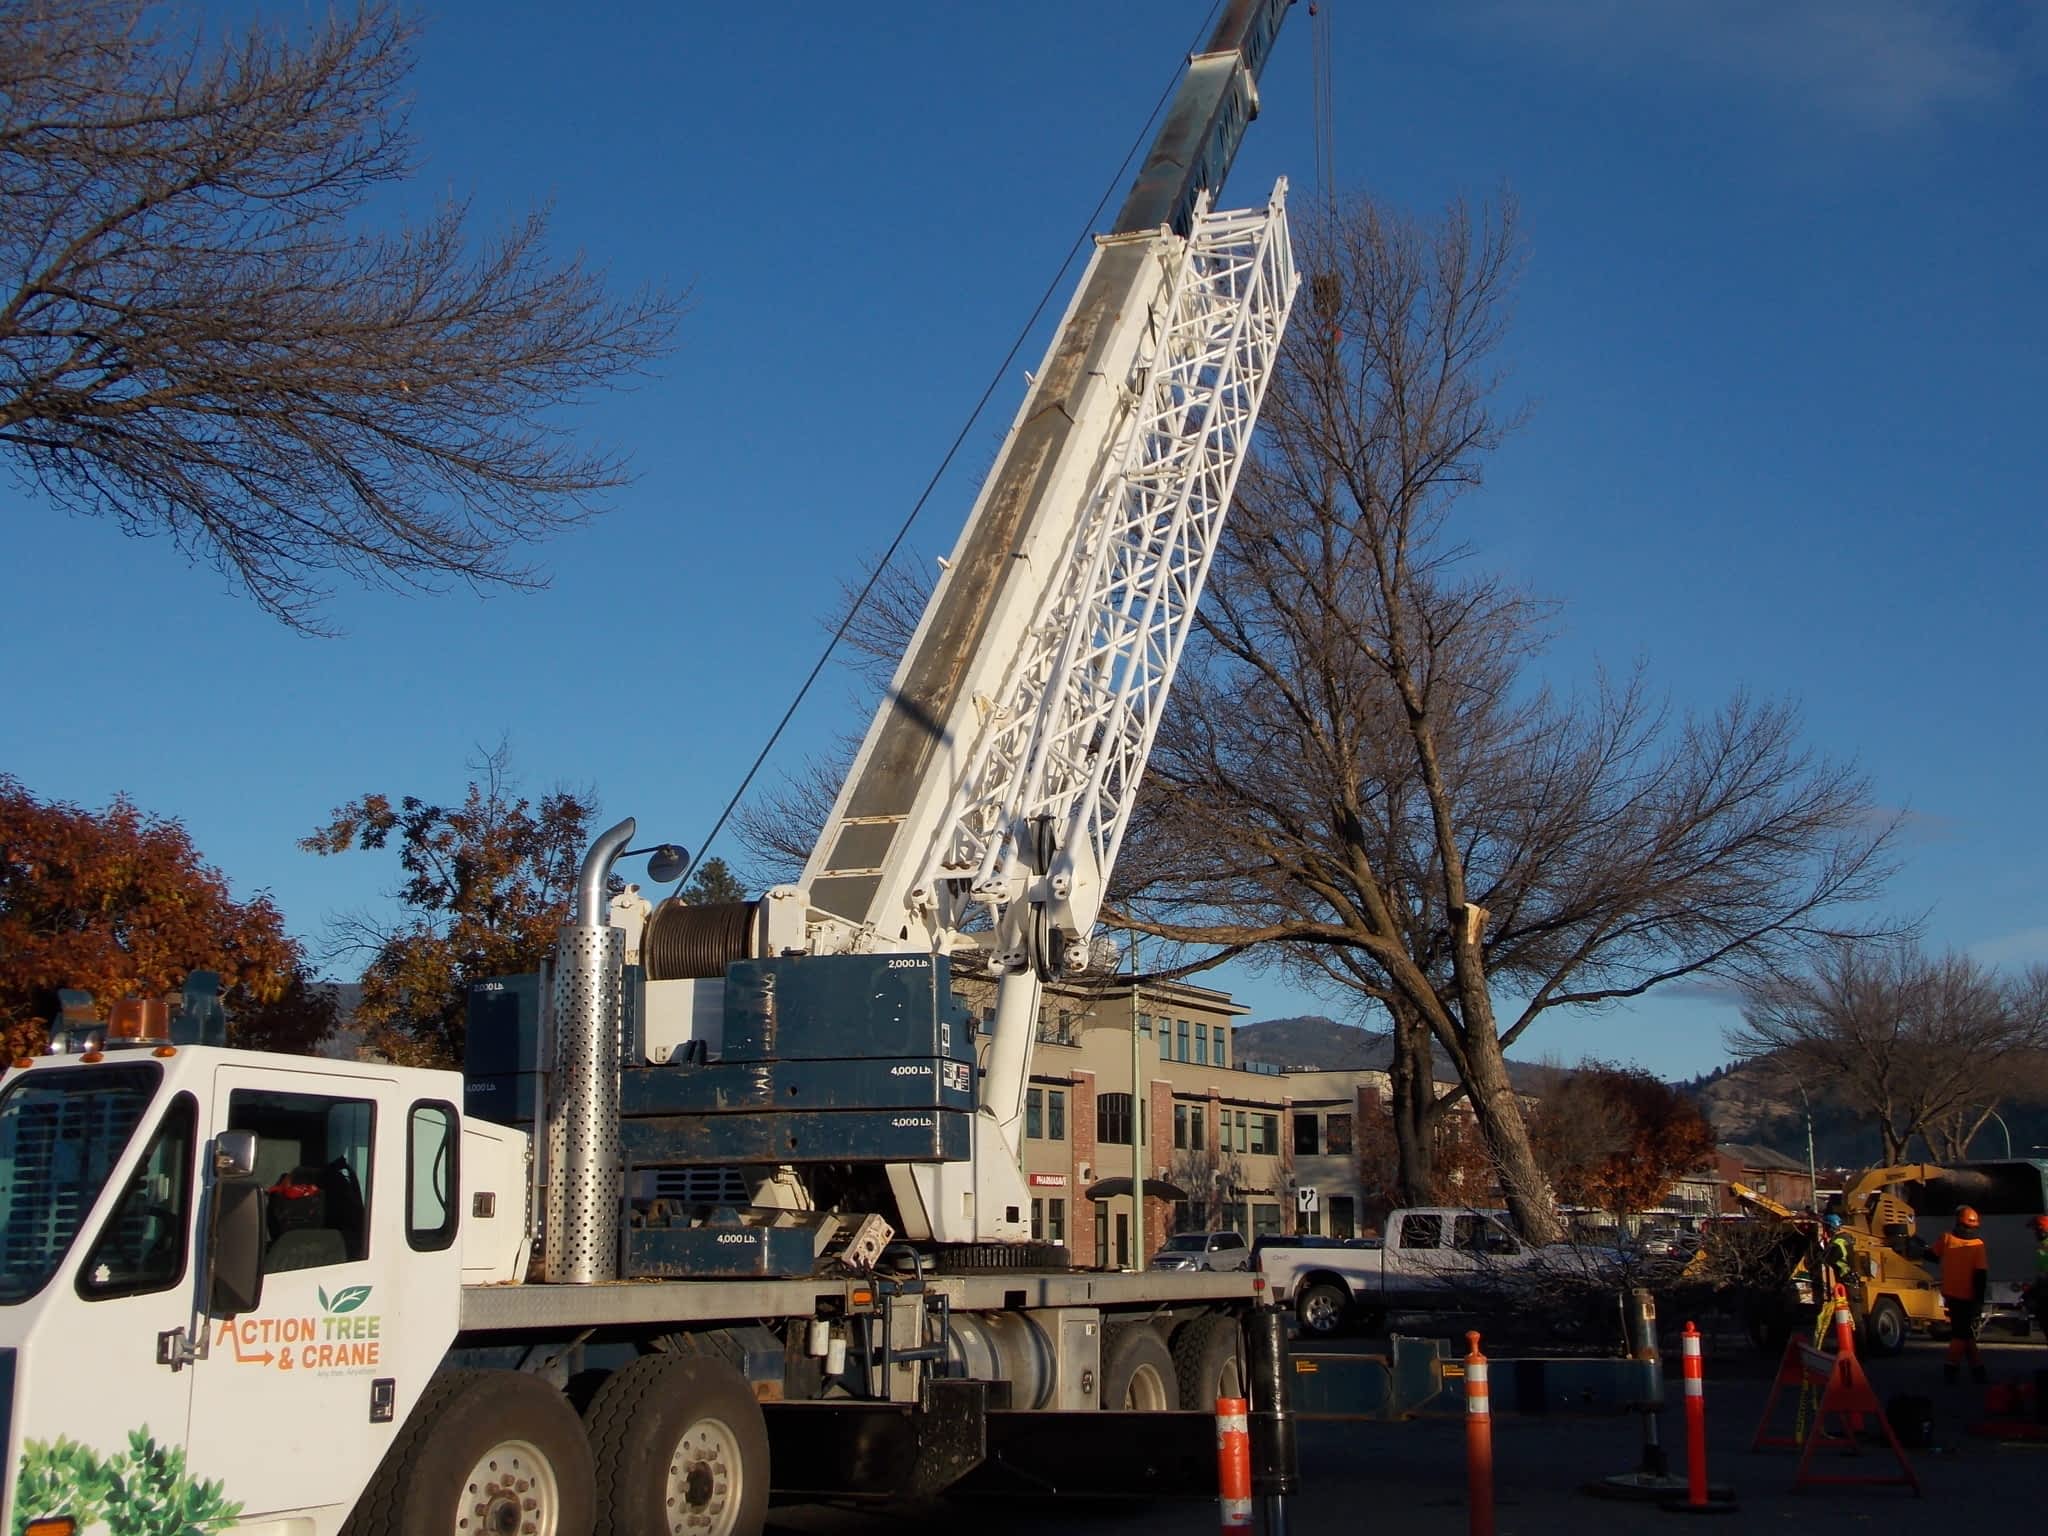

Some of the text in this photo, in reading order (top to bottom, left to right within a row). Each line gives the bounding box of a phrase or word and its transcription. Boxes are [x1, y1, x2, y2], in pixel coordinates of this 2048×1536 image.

[888, 959, 930, 969] 2,000 Lb.
[890, 1066, 933, 1076] 4,000 Lb.
[891, 1117, 919, 1128] 4,000
[716, 1234, 757, 1244] 4,000 Lb.
[216, 1316, 381, 1346] ACTION TREE
[278, 1342, 379, 1370] & CRANE
